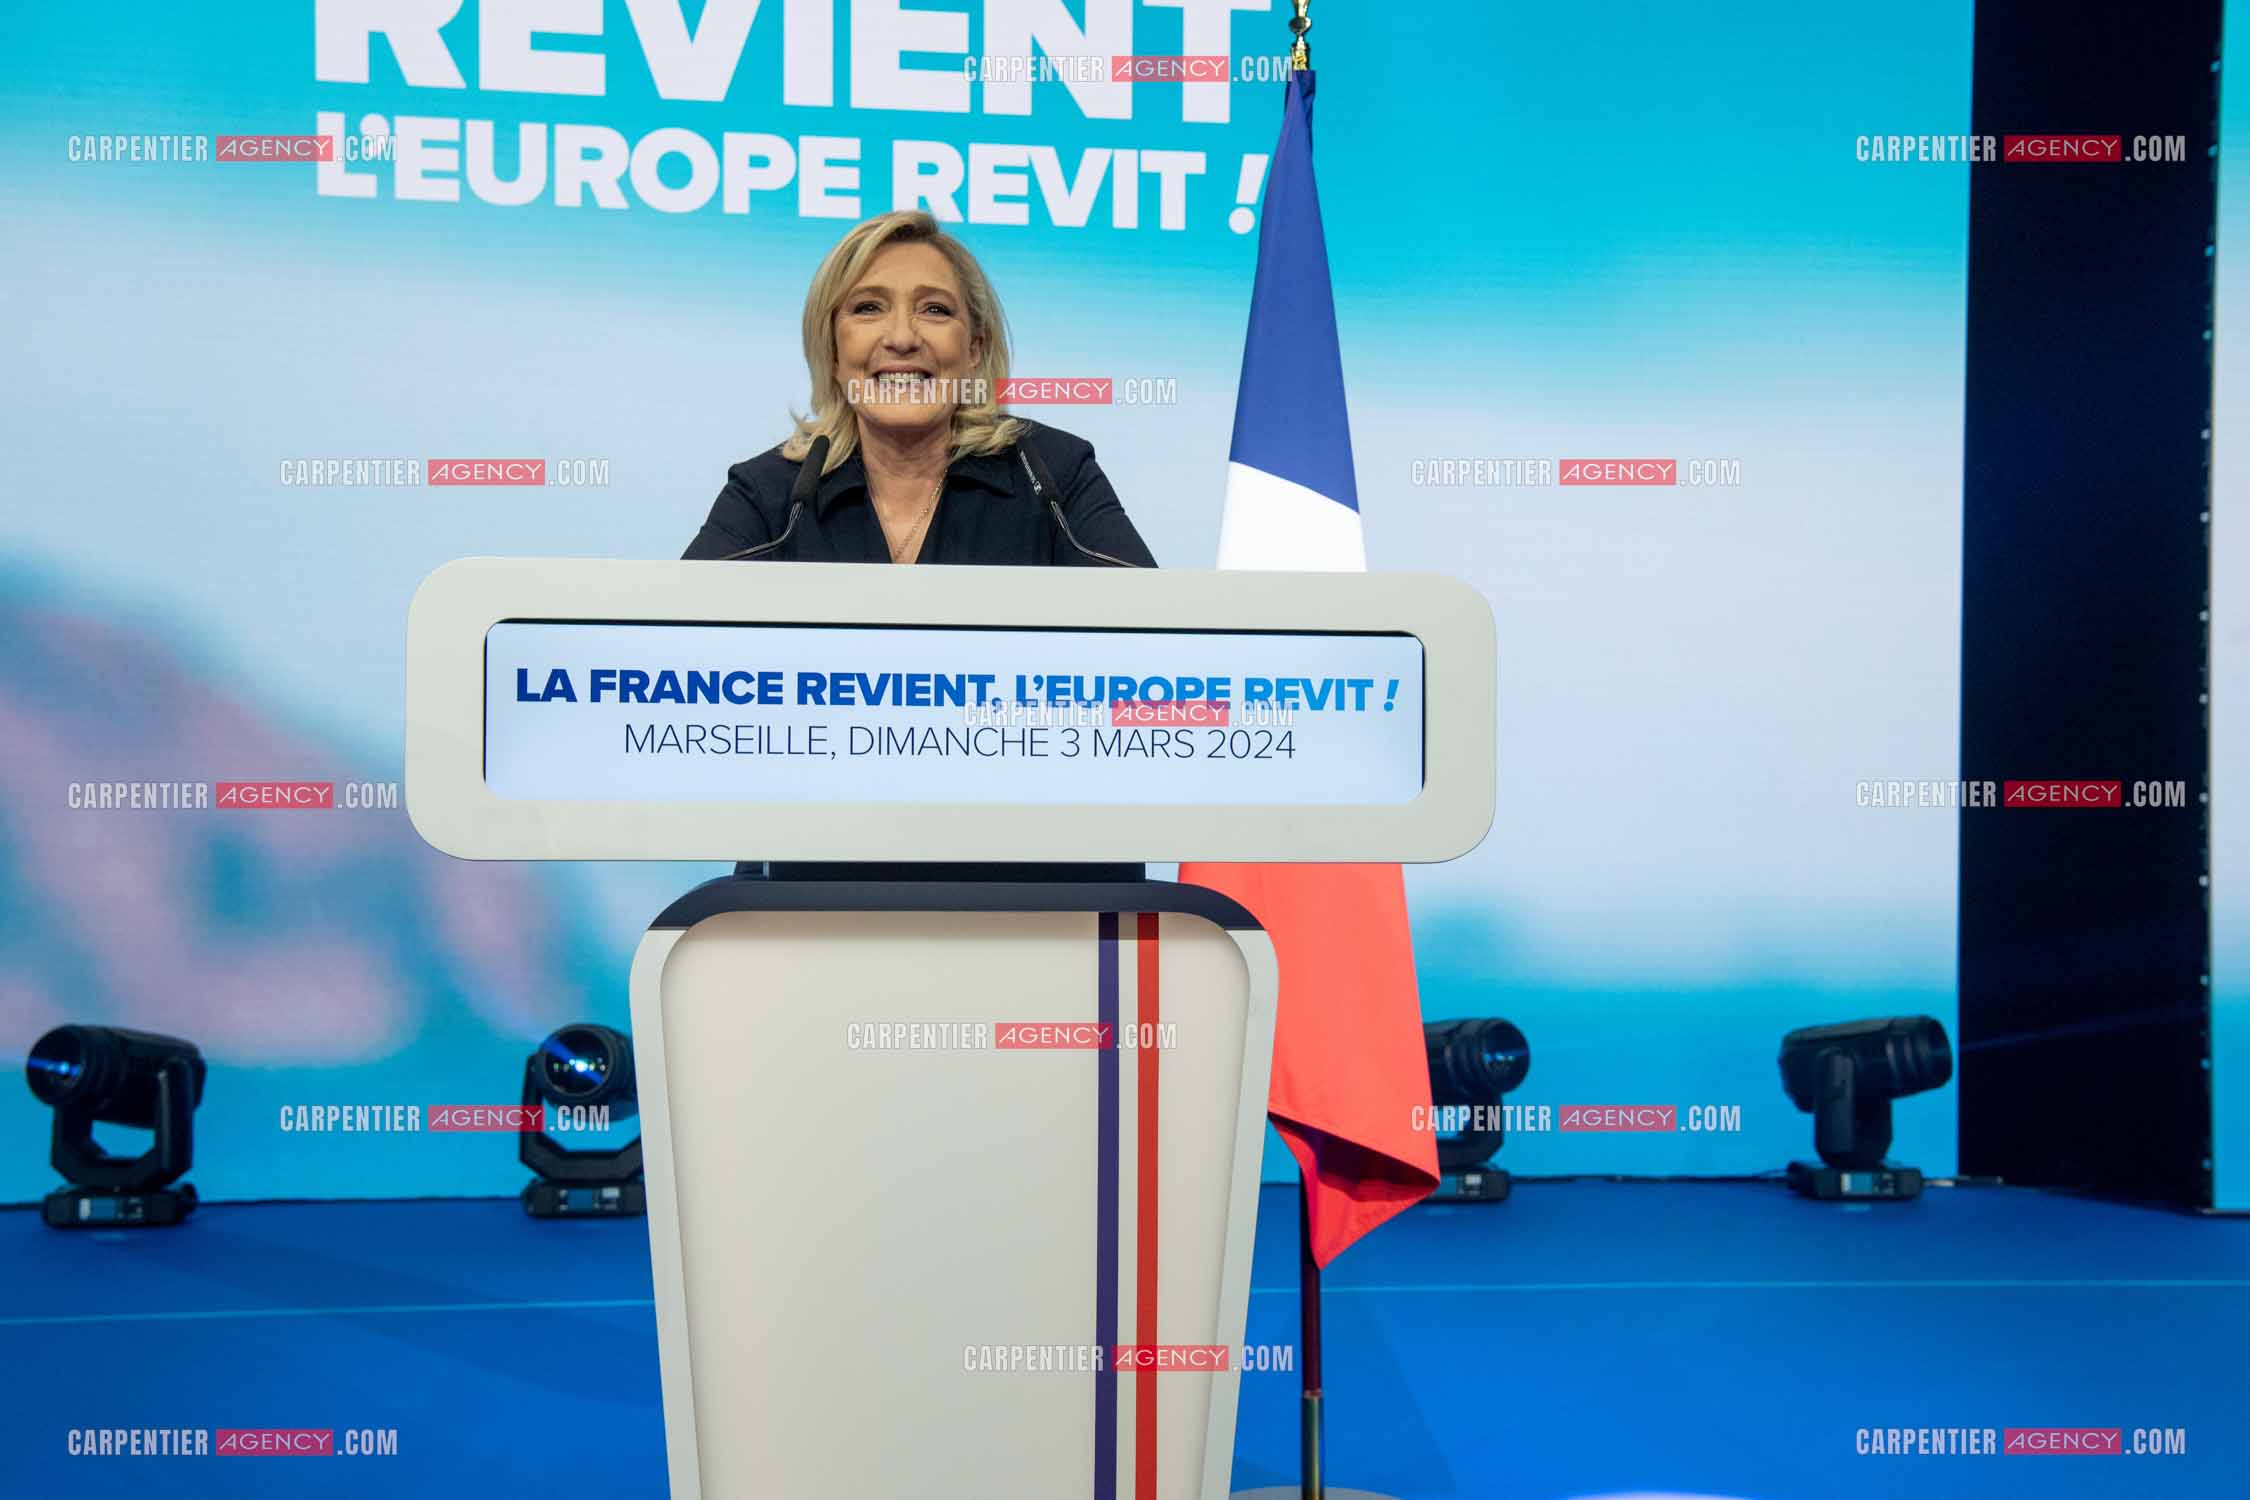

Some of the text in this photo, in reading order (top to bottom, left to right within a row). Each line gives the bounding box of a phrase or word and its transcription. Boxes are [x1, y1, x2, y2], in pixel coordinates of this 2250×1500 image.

[315, 0, 1272, 123] REVIENT
[892, 140, 1206, 230] REVIT
[1228, 153, 1269, 235] !
[516, 668, 578, 702] LA
[590, 668, 784, 705] FRANCE
[1244, 677, 1374, 711] REVIT
[1383, 679, 1400, 712] !
[625, 723, 1296, 760] MARSEILLE, DIMANCHE 3 MARS 2024
